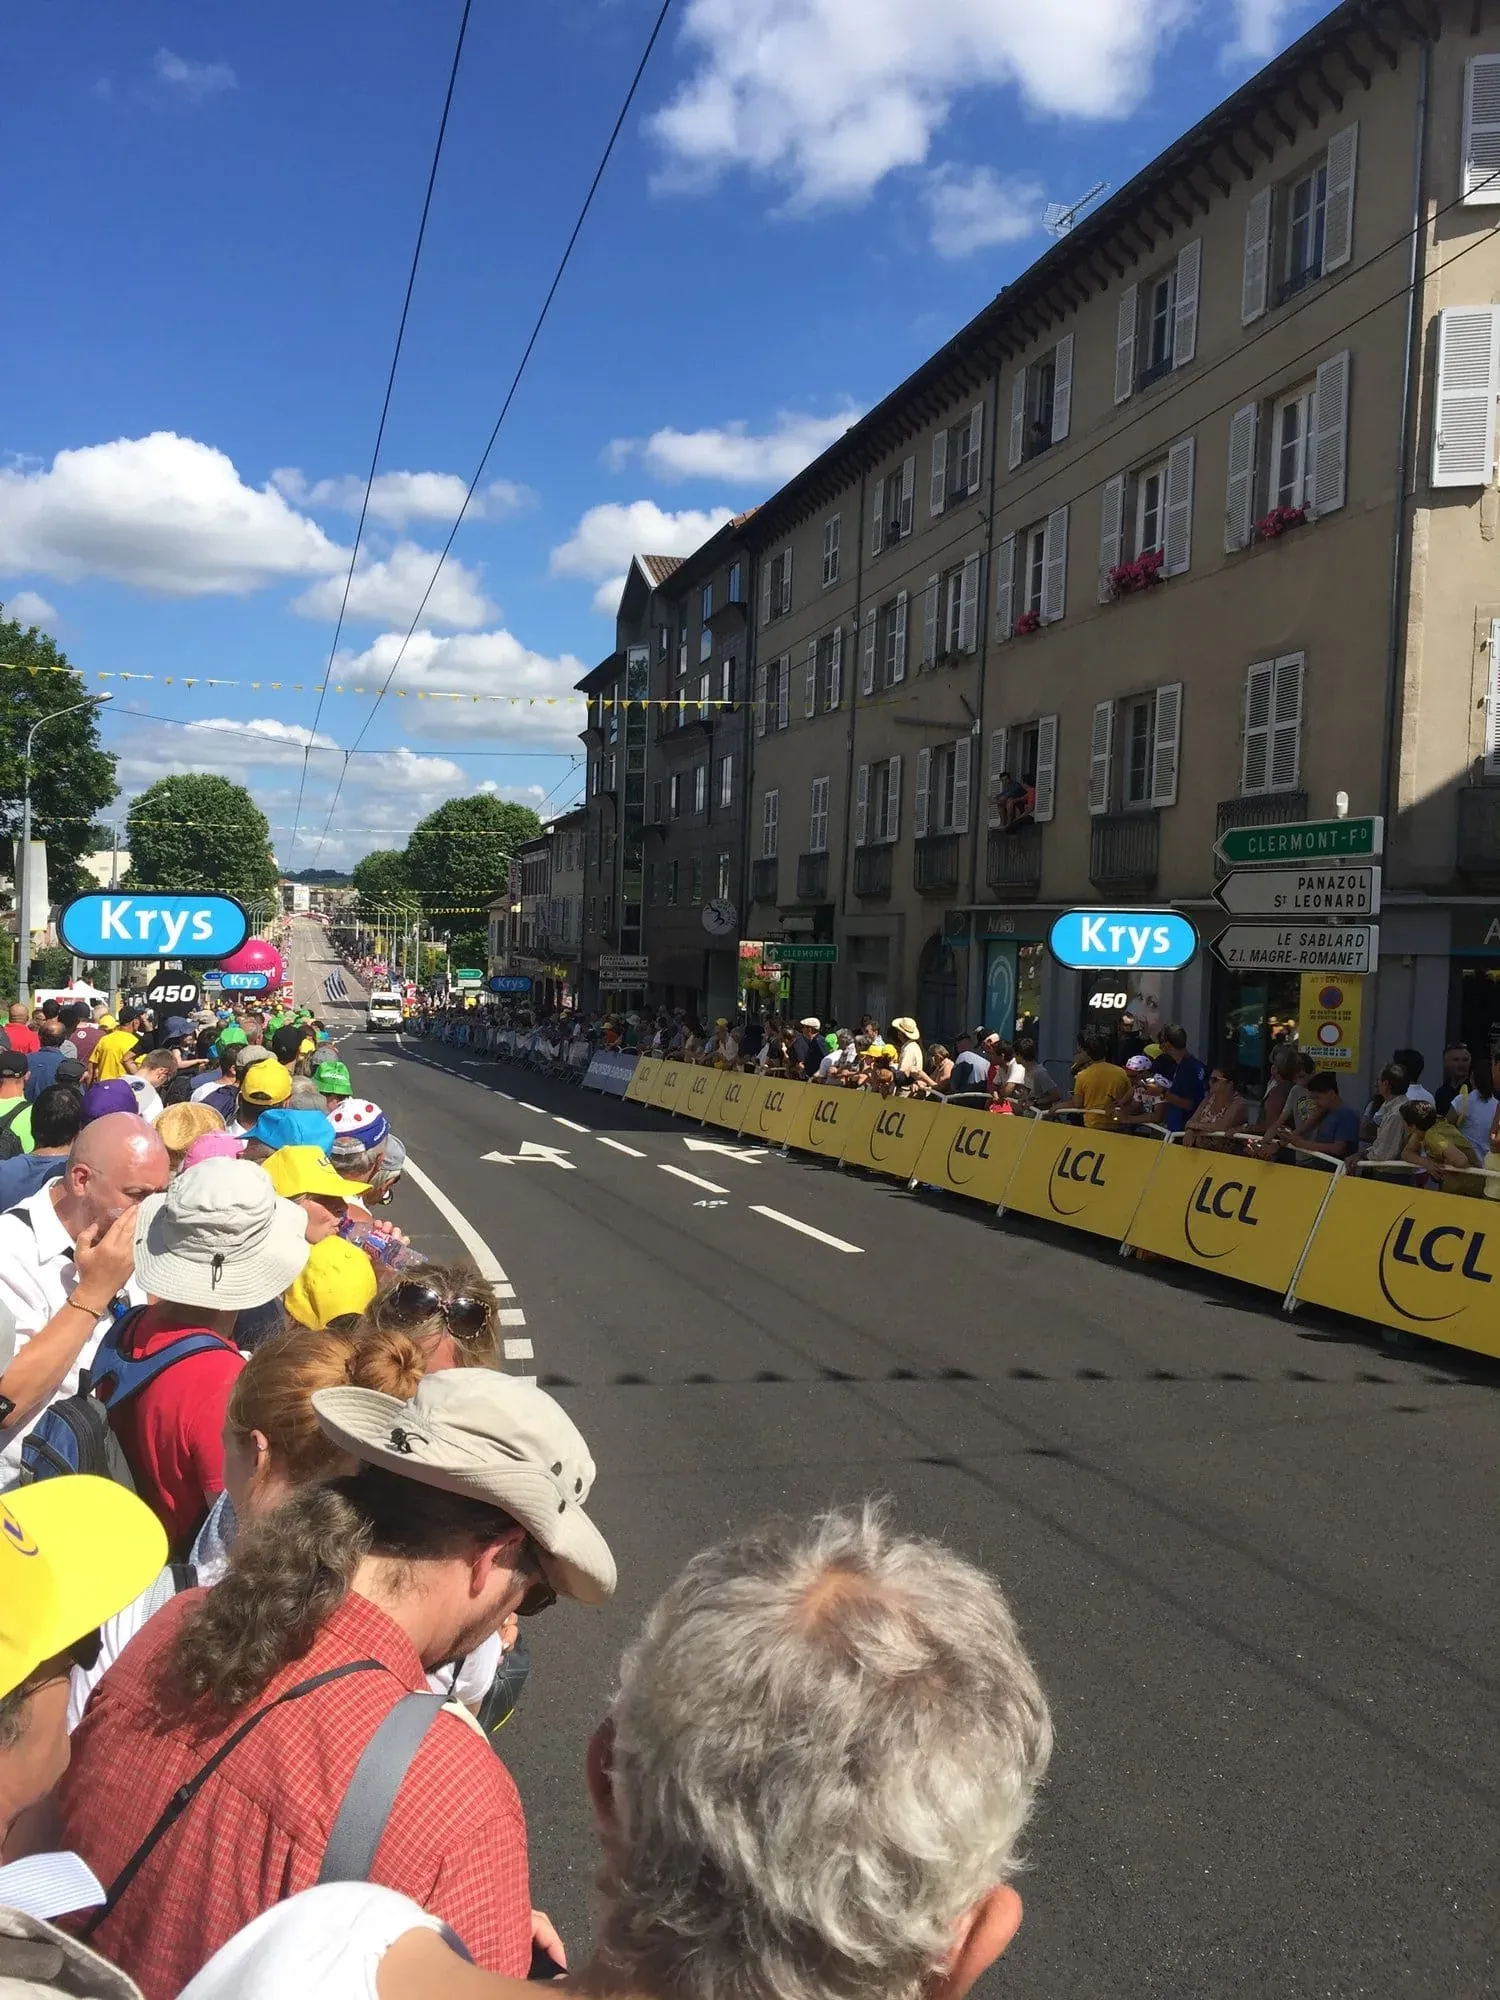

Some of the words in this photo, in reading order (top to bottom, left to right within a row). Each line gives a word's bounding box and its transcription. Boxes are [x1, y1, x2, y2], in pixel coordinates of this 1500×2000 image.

[1298, 875, 1366, 891] PANAZOL
[1294, 894, 1366, 908] LEONARD
[101, 900, 214, 953] Krys
[1081, 916, 1170, 965] Krys
[1277, 933, 1292, 946] LE
[1299, 933, 1365, 947] SABLARD
[230, 974, 260, 988] Krys
[498, 977, 524, 991] Krys
[149, 985, 197, 1002] 450
[1089, 993, 1127, 1008] 450
[692, 1076, 707, 1094] LCL
[725, 1083, 742, 1103] LCL
[765, 1090, 785, 1112] LCL
[814, 1100, 840, 1124] LCL
[876, 1109, 906, 1138] LCL
[954, 1126, 991, 1159] LCL
[1057, 1147, 1106, 1186] LCL
[1195, 1177, 1259, 1226] LCL
[1392, 1217, 1492, 1283] LCL
